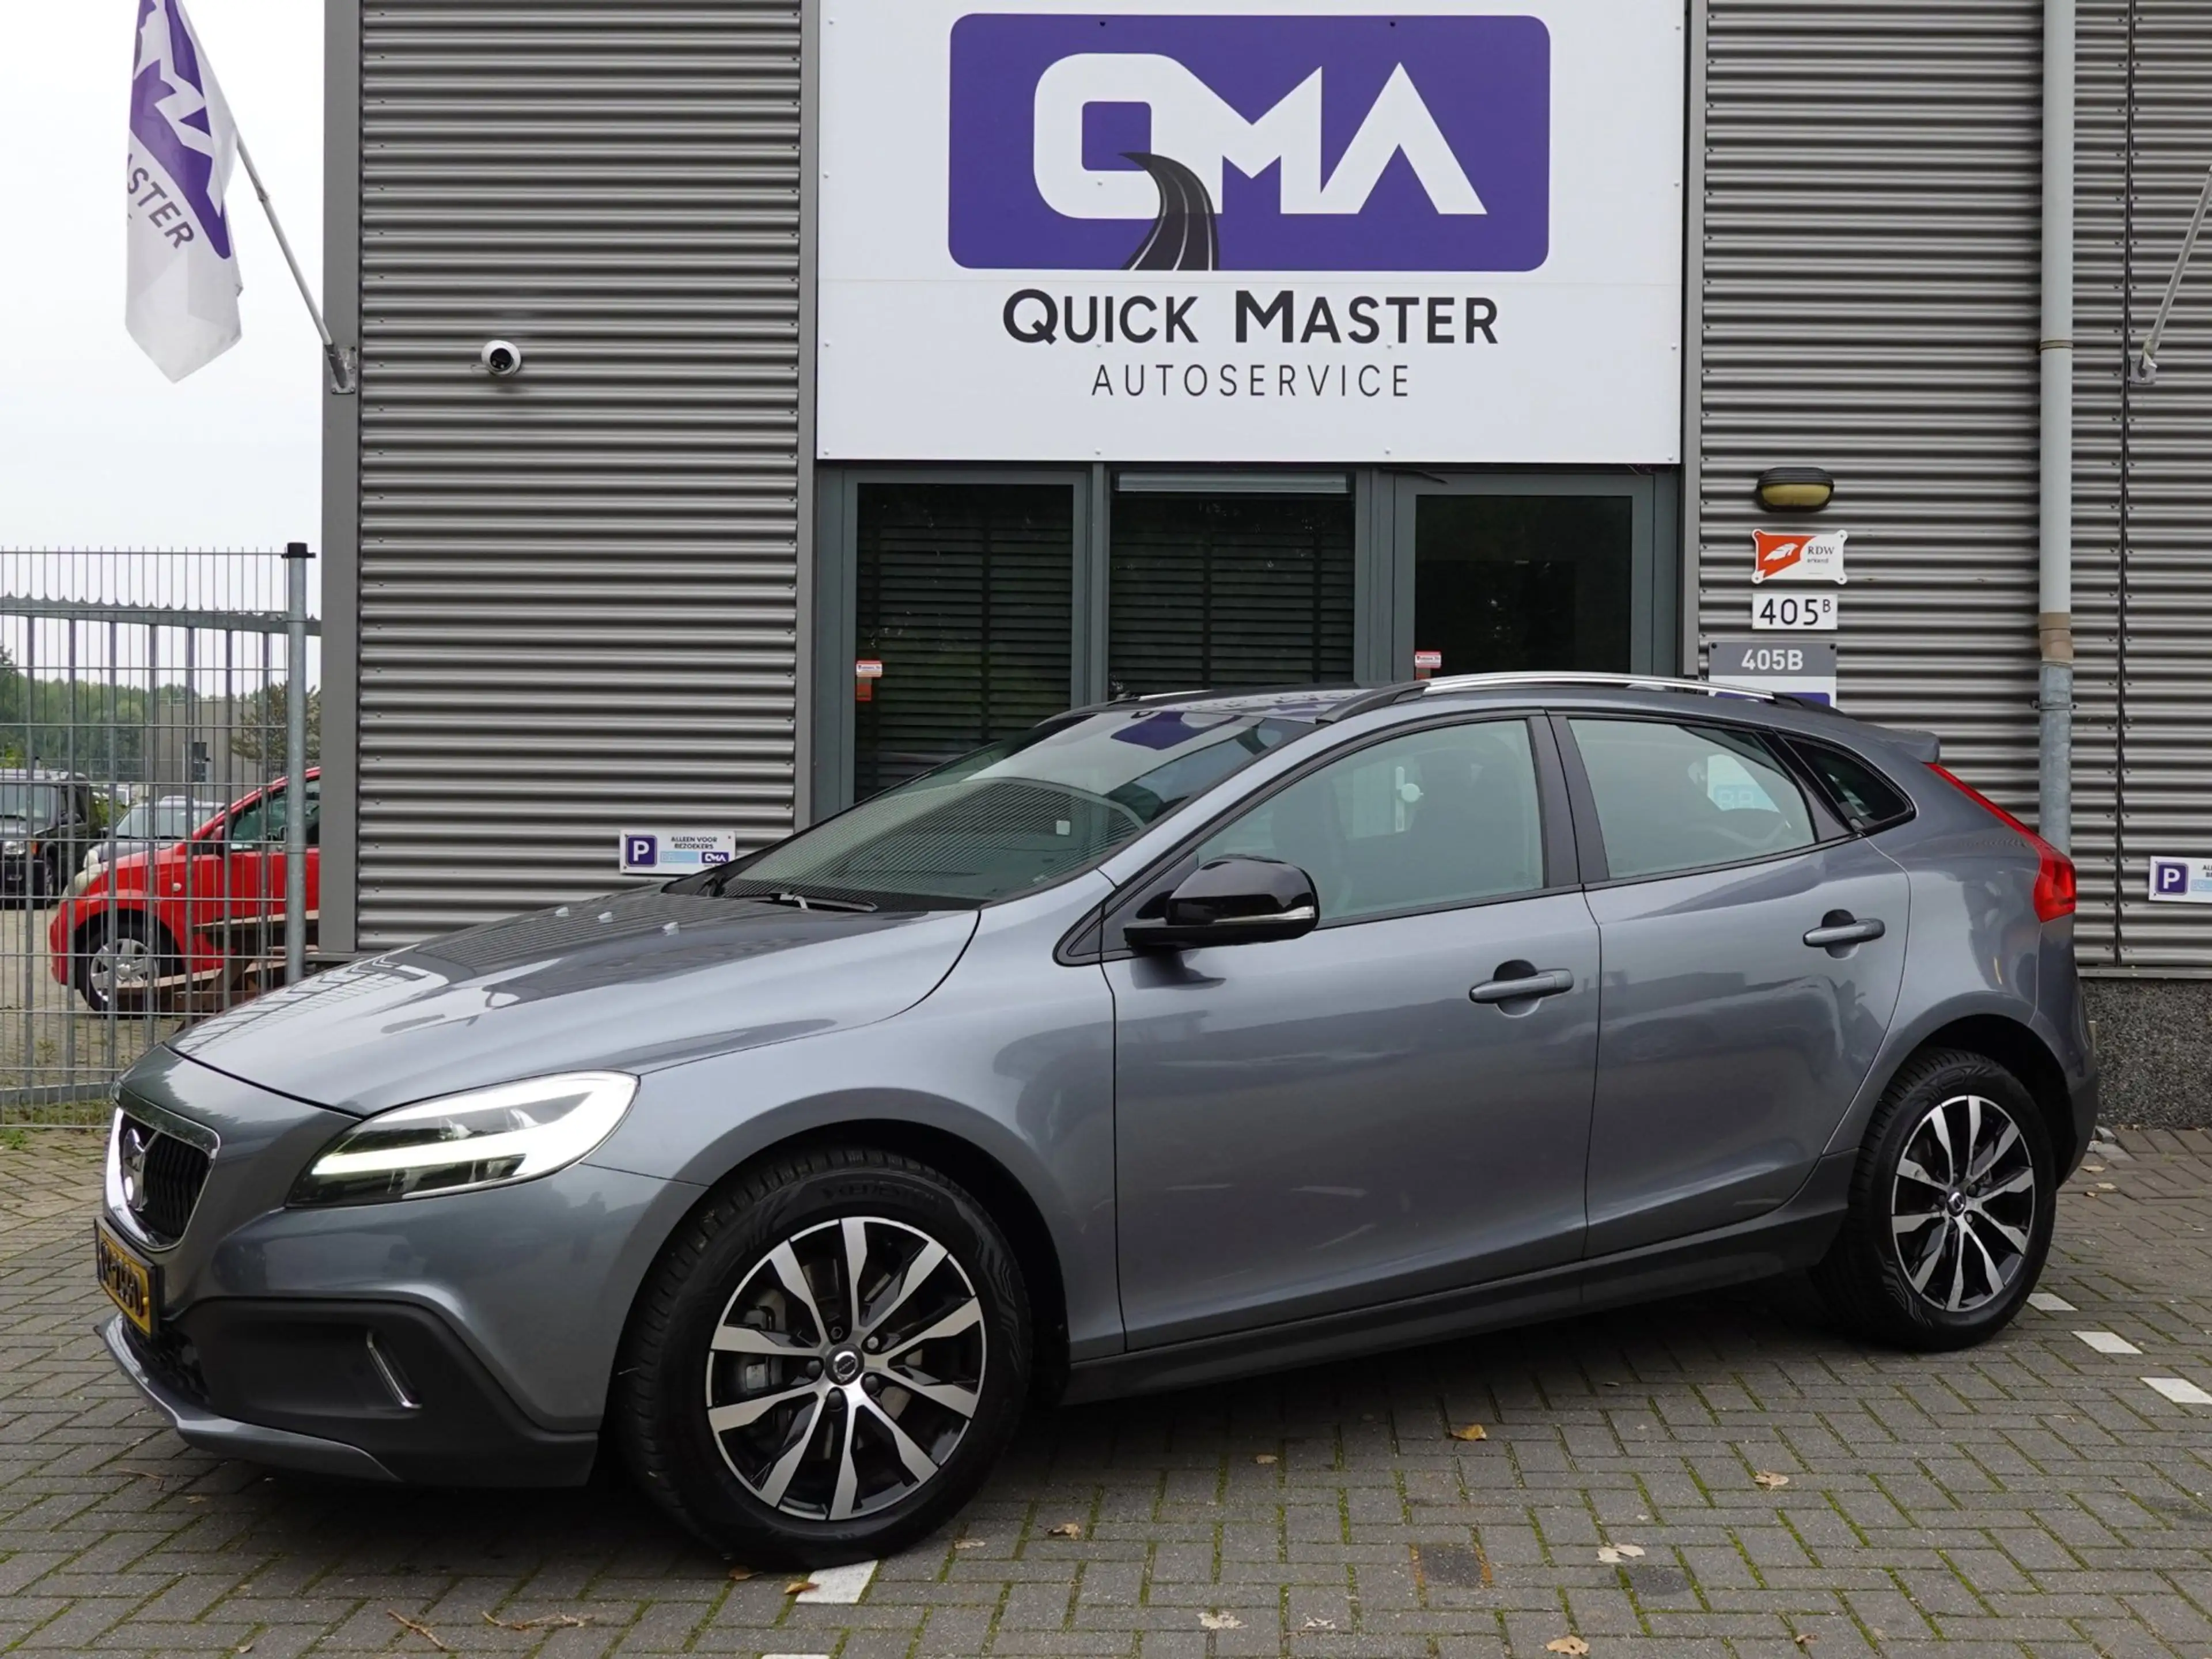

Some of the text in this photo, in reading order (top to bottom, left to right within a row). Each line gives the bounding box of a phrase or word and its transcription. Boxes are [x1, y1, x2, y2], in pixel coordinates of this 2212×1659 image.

[1034, 53, 1487, 219] QMA
[127, 152, 195, 249] STER
[1003, 289, 1499, 345] QUICK MASTER
[1092, 364, 1409, 397] AUTOSERVICE
[1808, 546, 1835, 555] RDW
[1741, 649, 1804, 671] 405B
[633, 841, 649, 862] P
[2163, 868, 2180, 889] P
